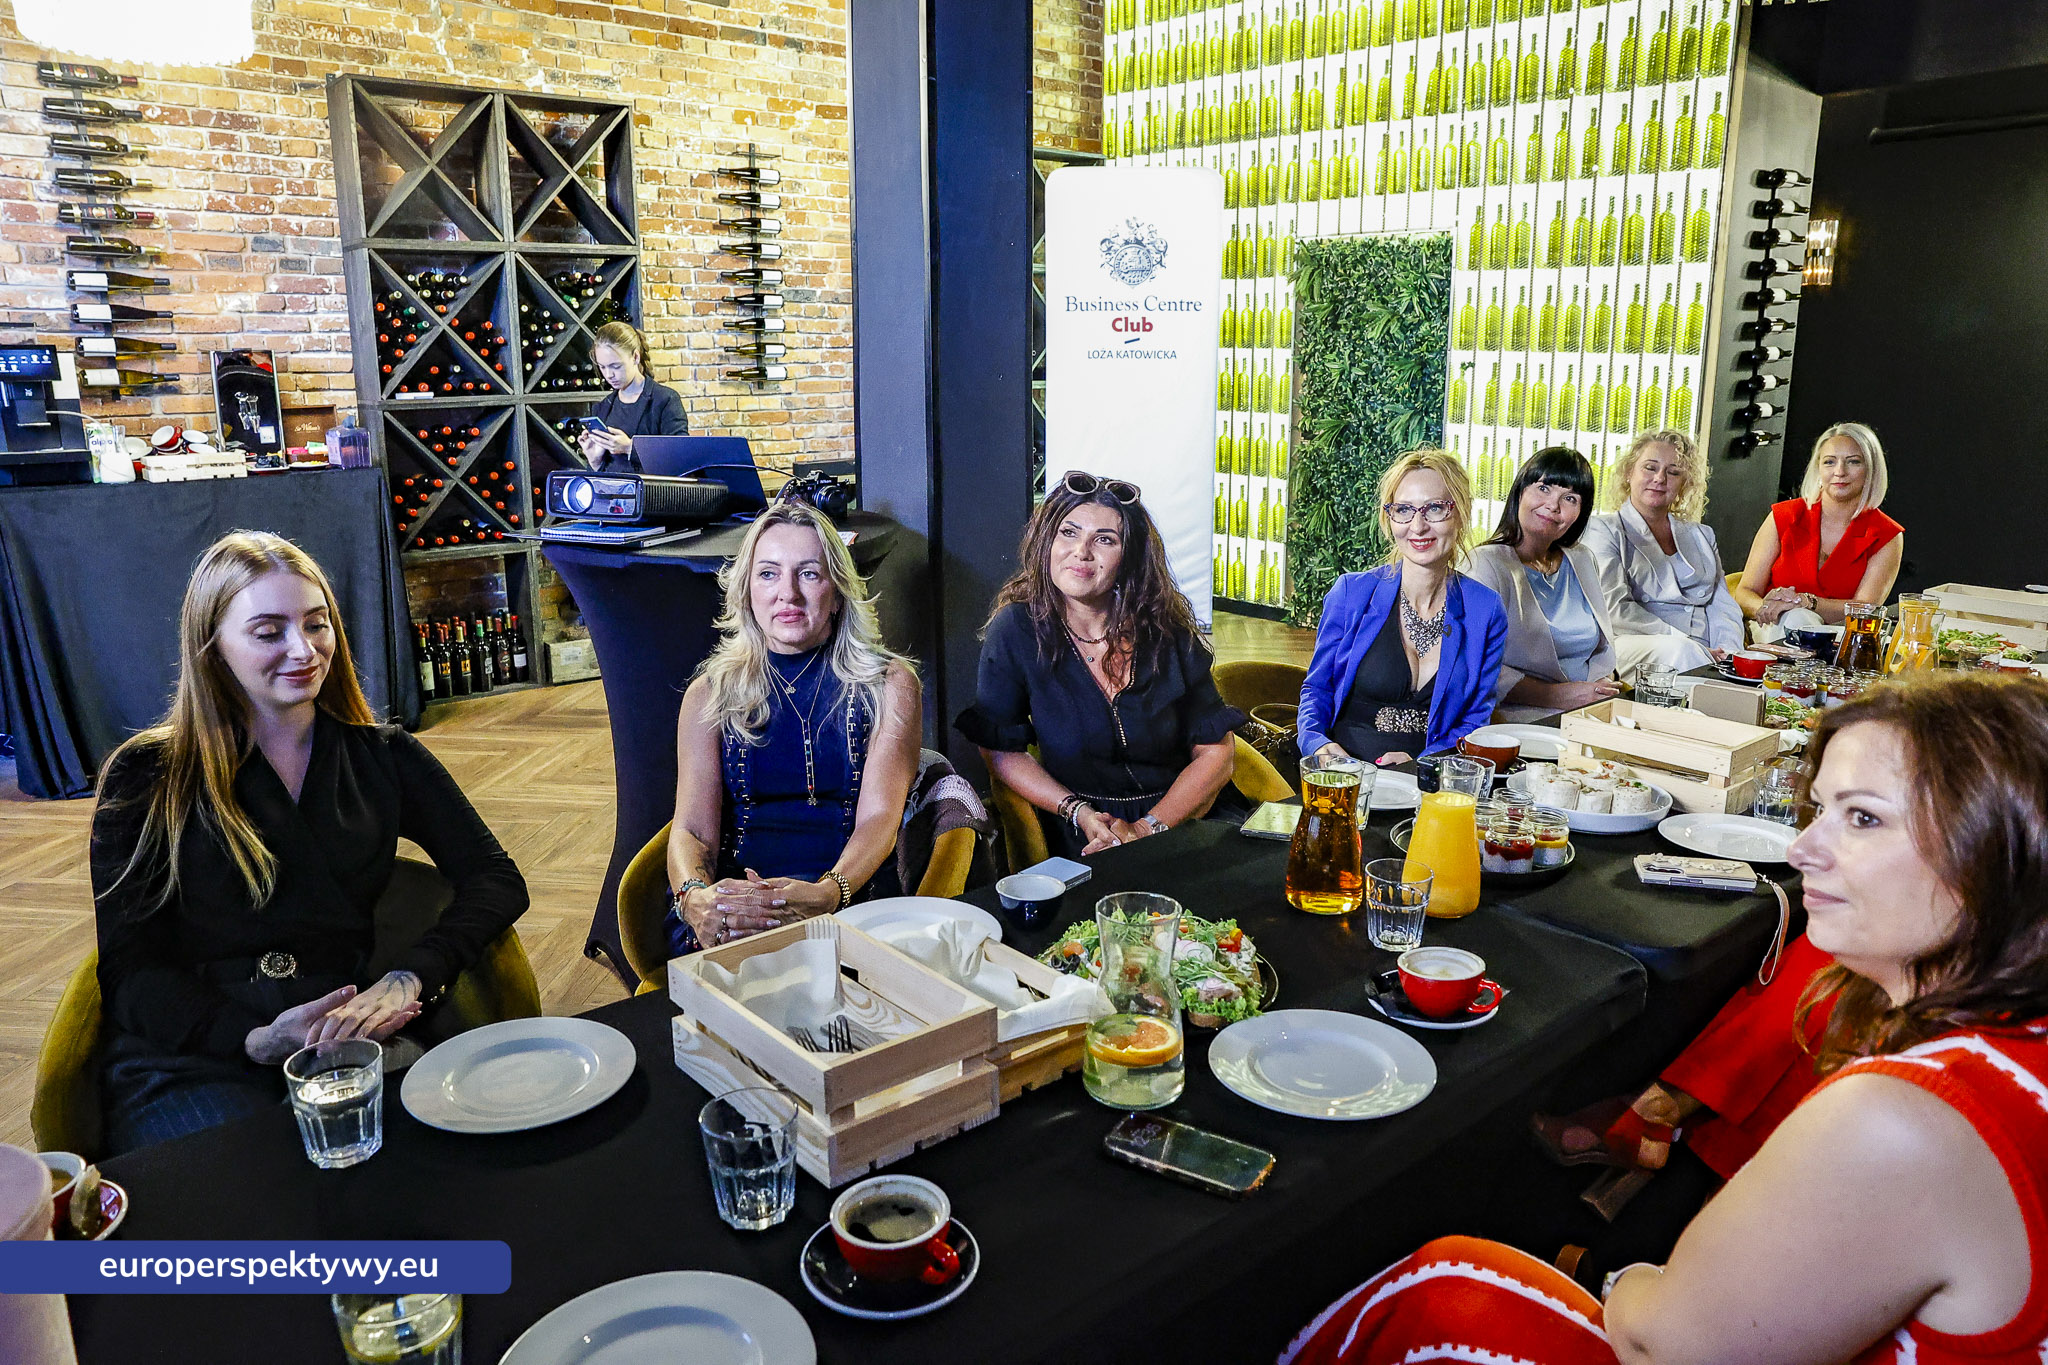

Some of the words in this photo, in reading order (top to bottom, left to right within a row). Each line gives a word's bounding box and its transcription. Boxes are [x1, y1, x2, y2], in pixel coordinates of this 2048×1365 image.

[1065, 295, 1139, 312] Business
[1144, 295, 1202, 312] Centre
[1111, 316, 1154, 333] Club
[1116, 350, 1177, 360] KATOWICKA
